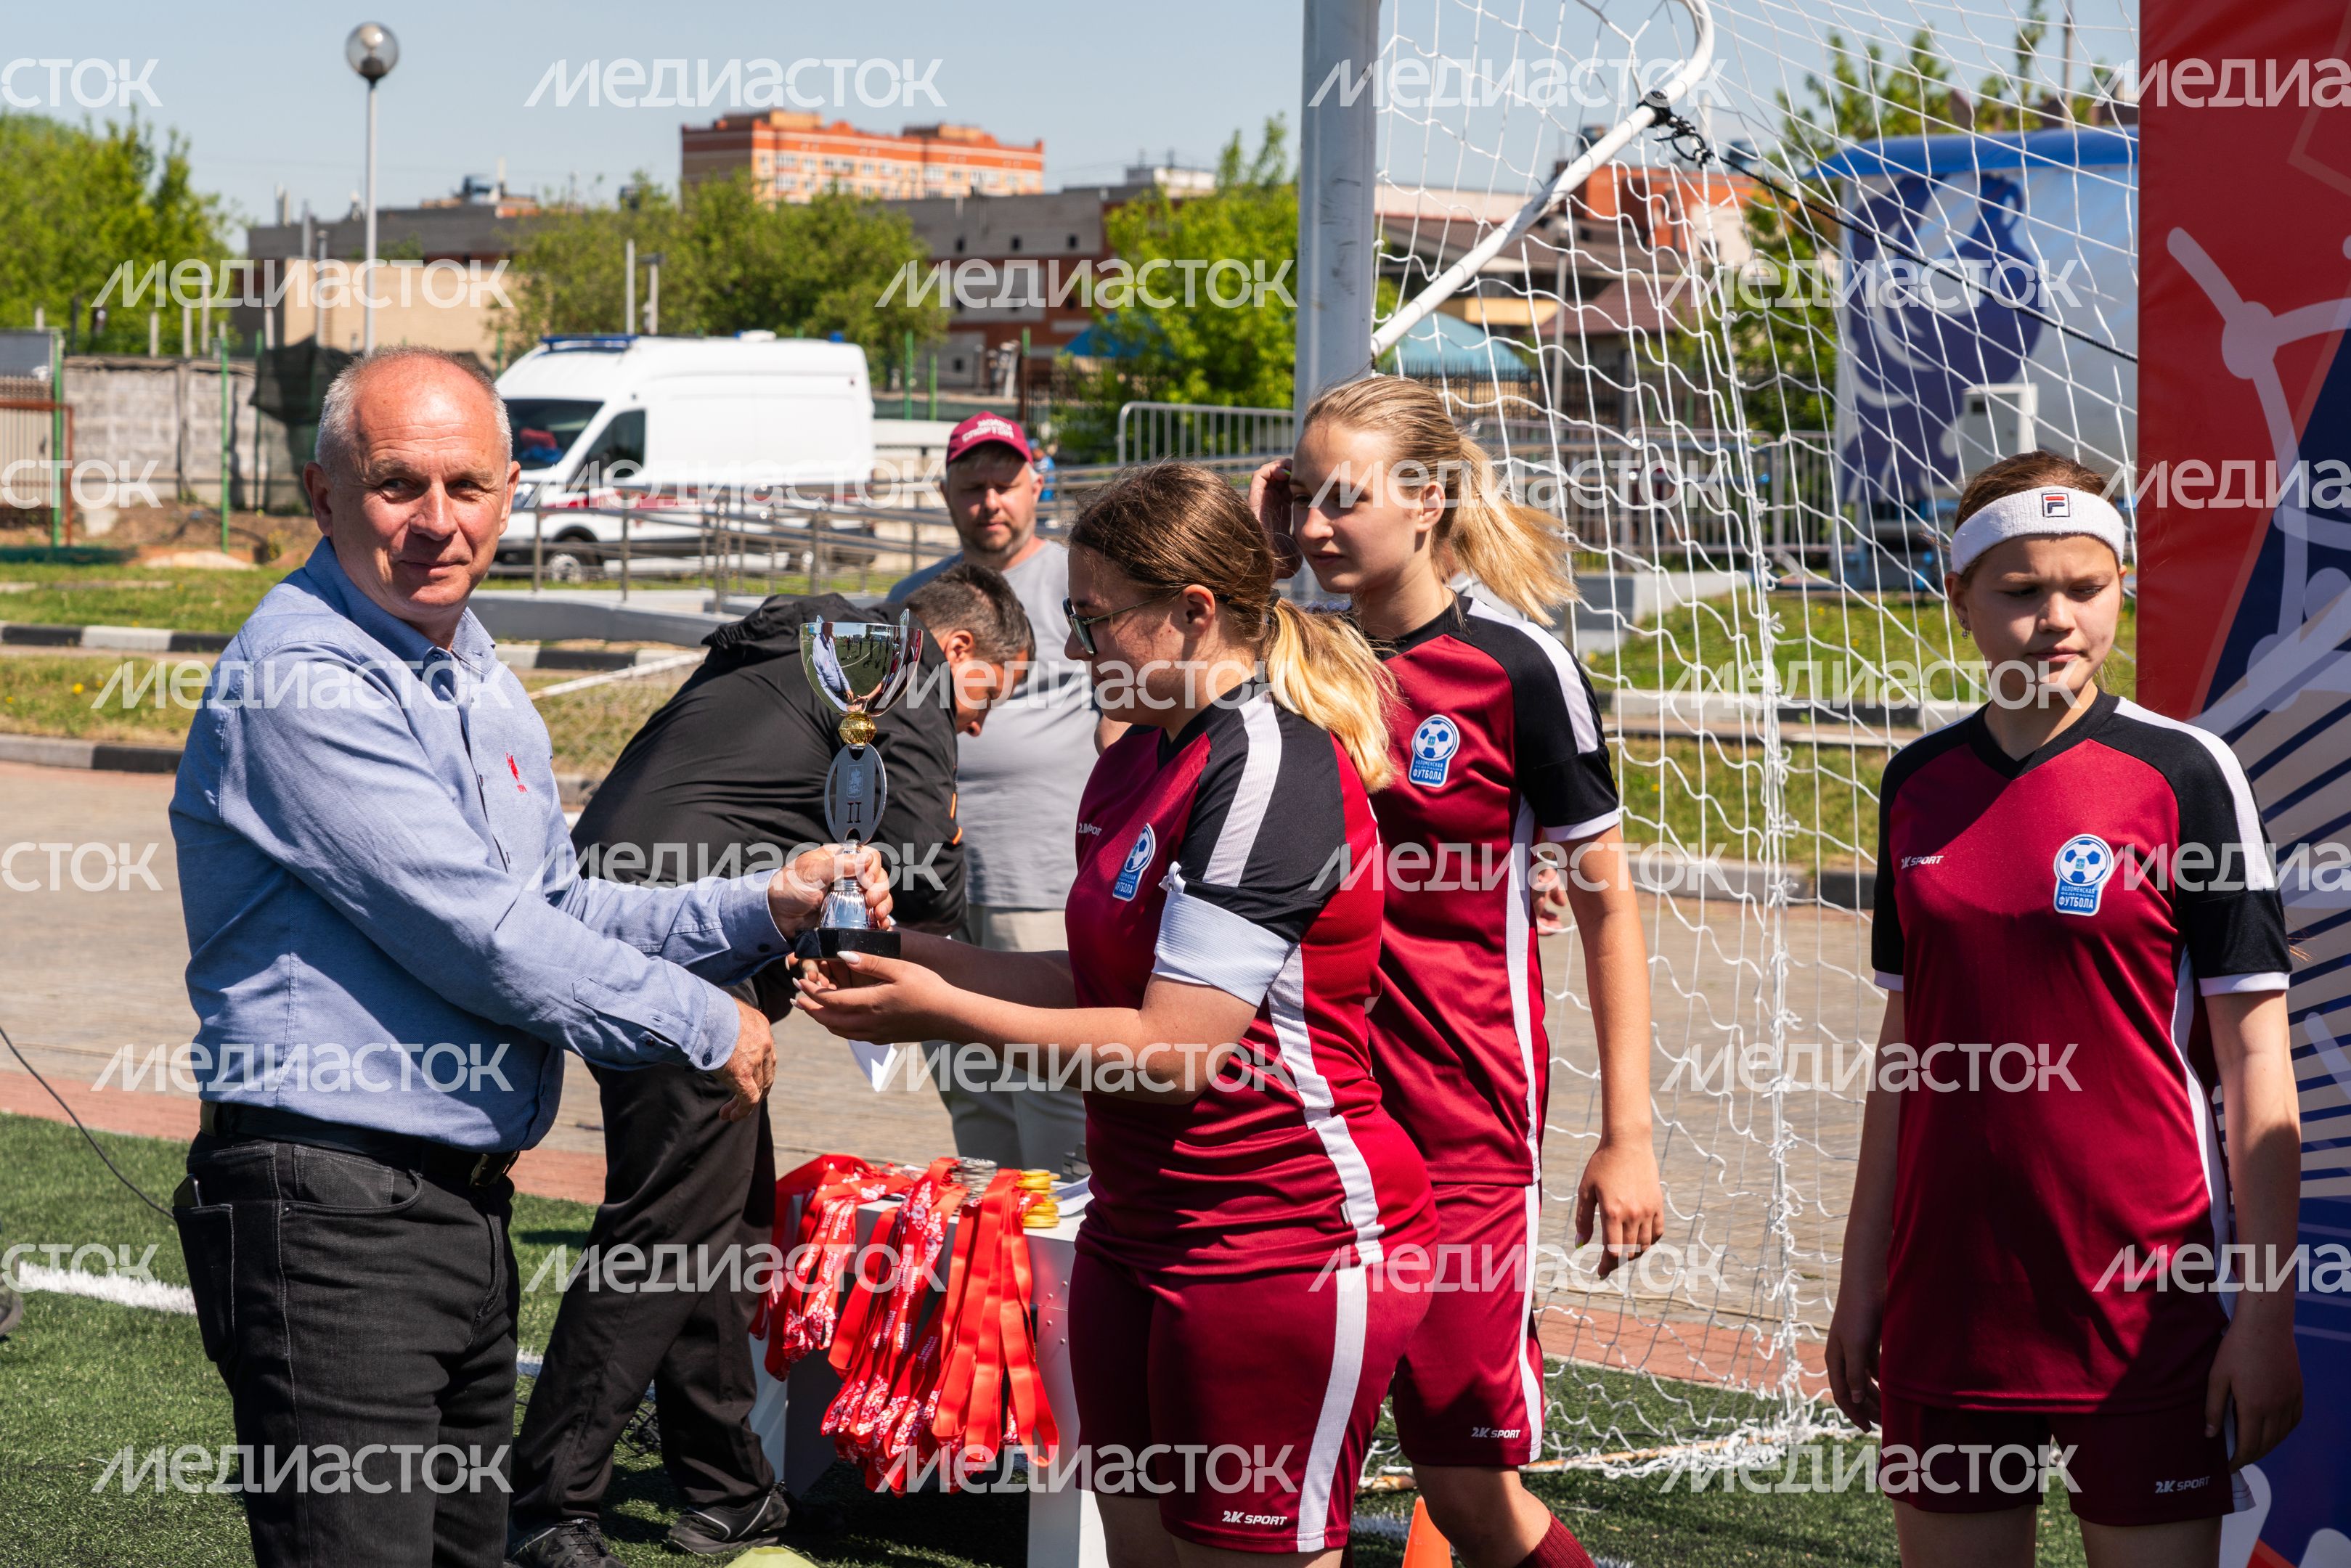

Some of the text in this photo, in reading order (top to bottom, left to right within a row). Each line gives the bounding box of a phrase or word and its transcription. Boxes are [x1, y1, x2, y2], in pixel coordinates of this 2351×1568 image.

[1412, 769, 1442, 781] ФУТБОЛА
[1910, 855, 1944, 866] SPORT
[2058, 896, 2094, 909] ФУТБОЛА
[1471, 1426, 1521, 1439] 2K SPORT
[2154, 1475, 2211, 1494] 2K SPORT
[1221, 1510, 1288, 1525] 2K SPORT
